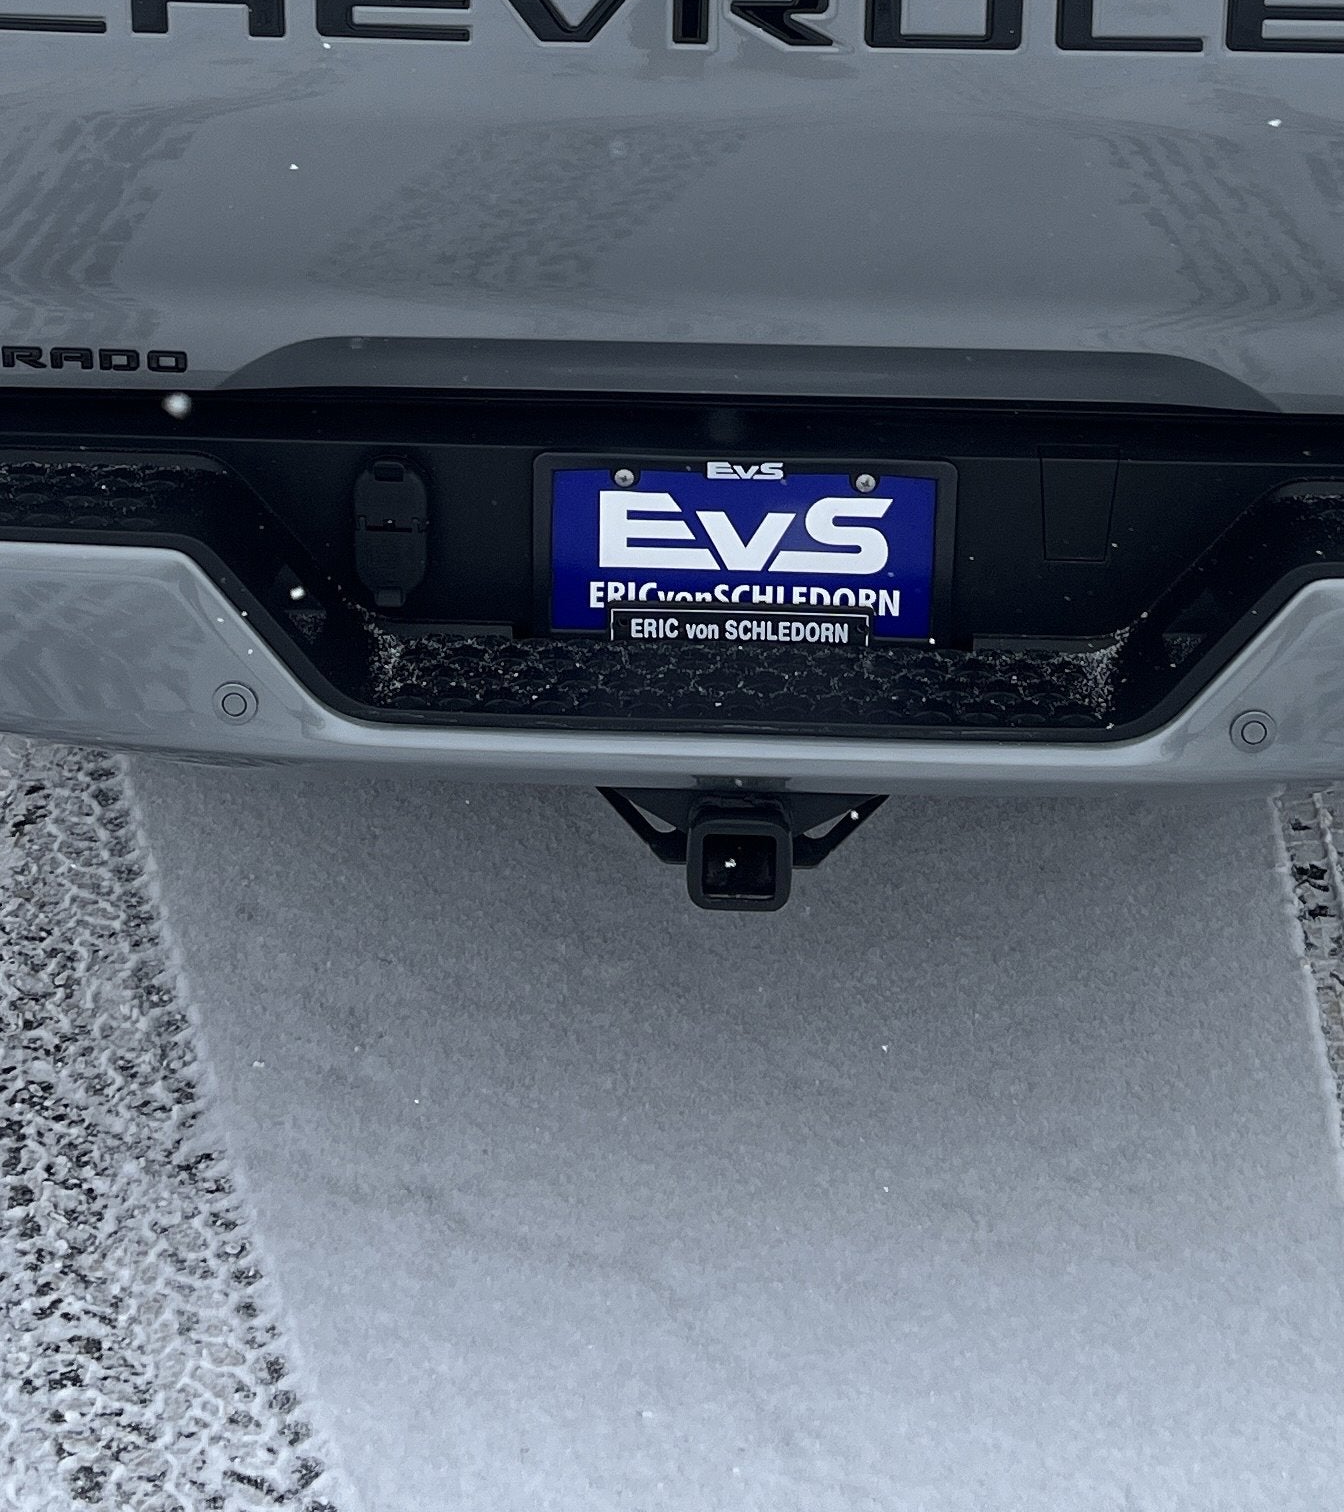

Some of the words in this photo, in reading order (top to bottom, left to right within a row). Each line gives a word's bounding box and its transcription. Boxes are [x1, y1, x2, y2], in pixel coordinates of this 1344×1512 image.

[631, 618, 679, 639] ERIC
[685, 623, 719, 640] von
[725, 619, 849, 644] SCHLEDORN
